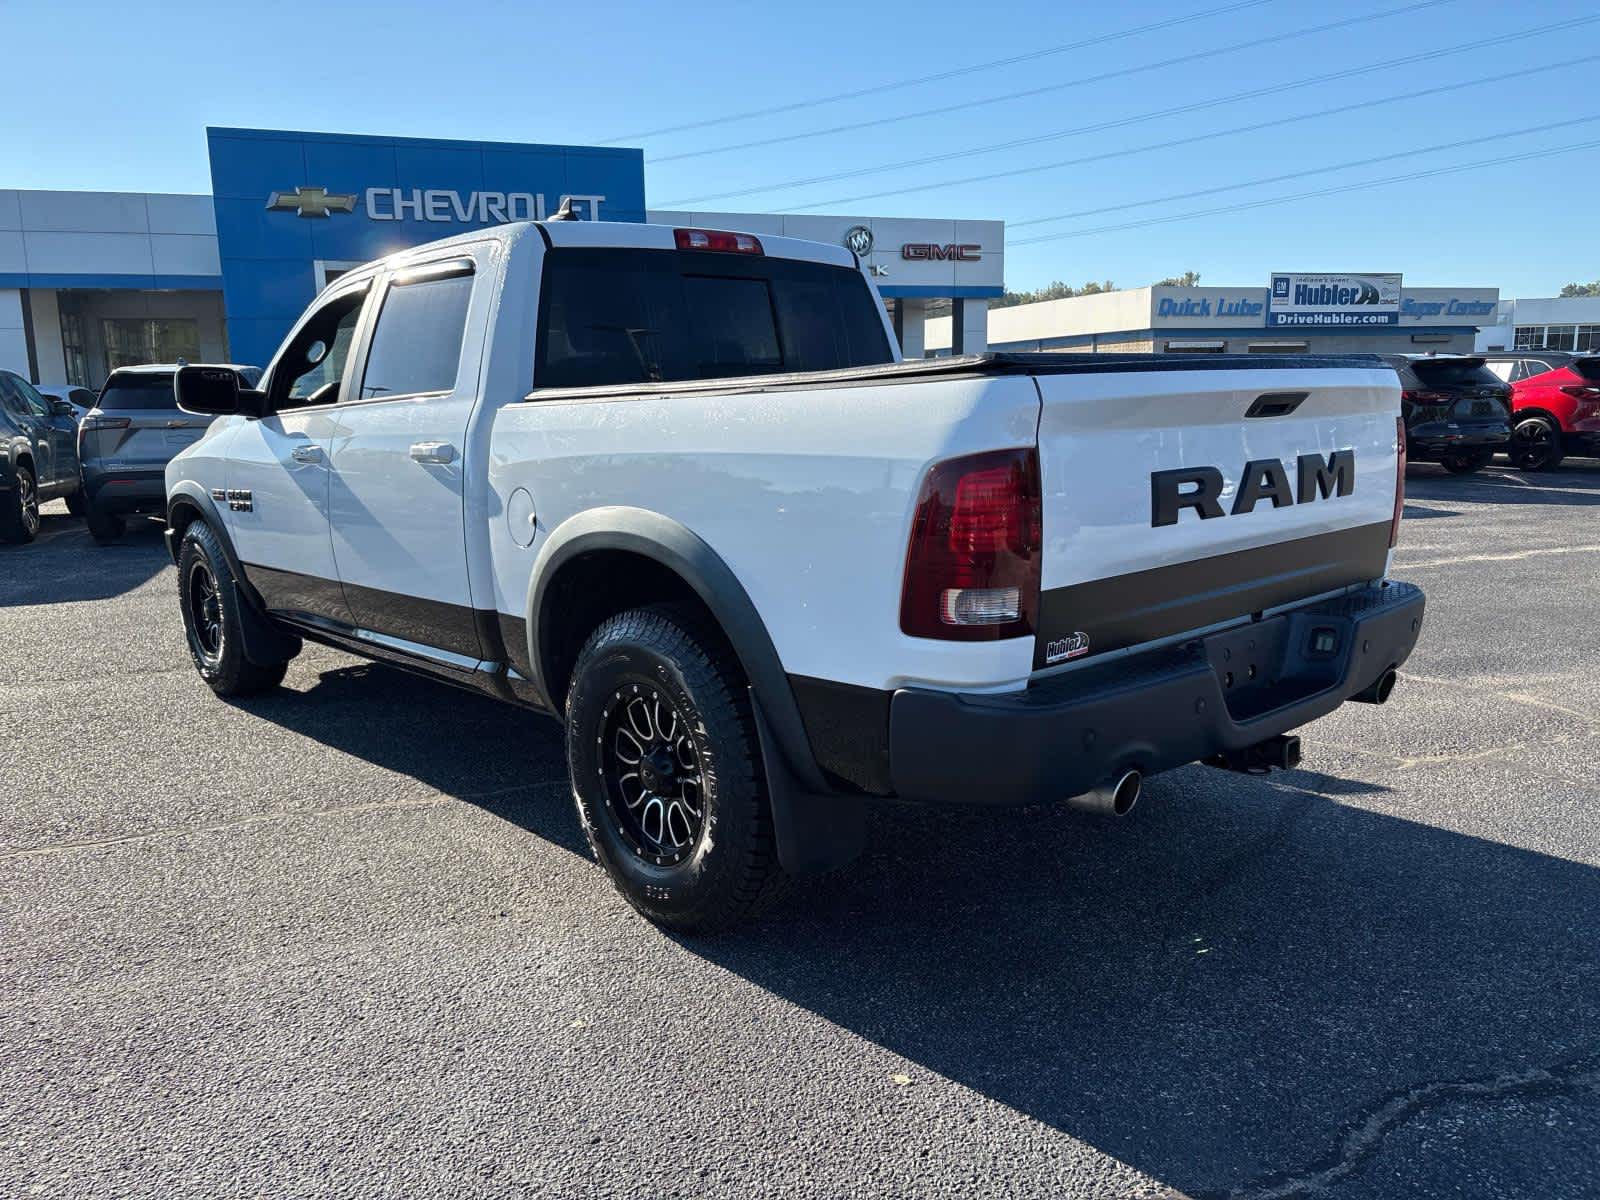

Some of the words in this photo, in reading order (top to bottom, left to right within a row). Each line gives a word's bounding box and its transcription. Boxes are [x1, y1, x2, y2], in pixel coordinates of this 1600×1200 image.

[903, 243, 982, 261] GMC
[1295, 284, 1359, 305] Hubler
[1158, 297, 1212, 318] Quick
[1216, 298, 1263, 316] Lube
[1277, 313, 1389, 325] DriveHubler.com
[1151, 449, 1355, 528] RAM
[1046, 637, 1080, 658] Hubler
